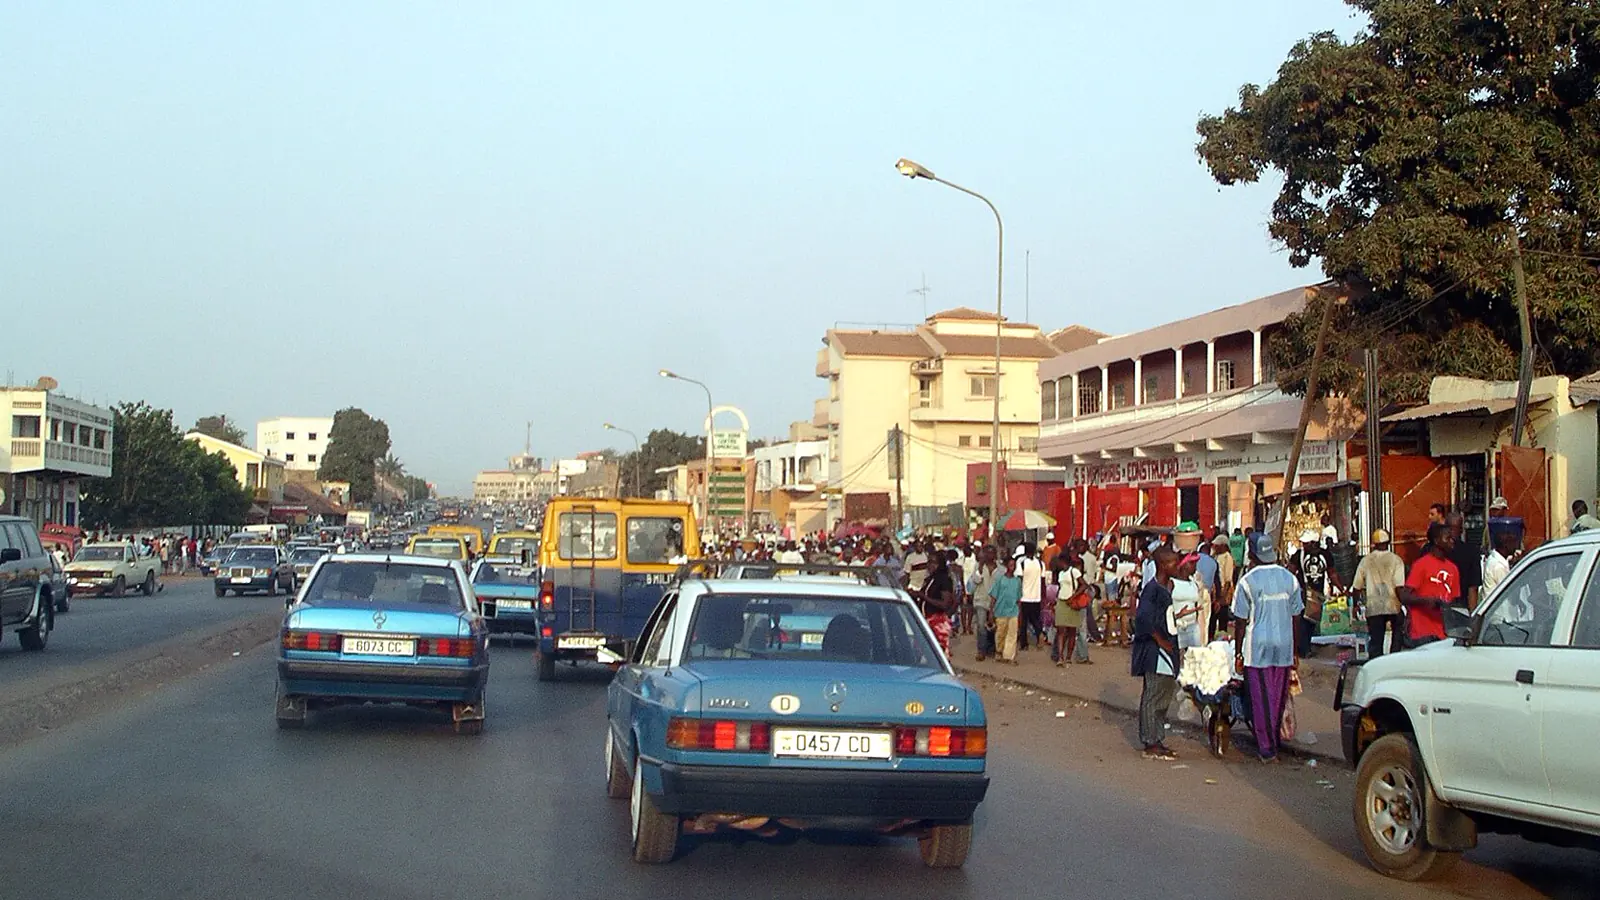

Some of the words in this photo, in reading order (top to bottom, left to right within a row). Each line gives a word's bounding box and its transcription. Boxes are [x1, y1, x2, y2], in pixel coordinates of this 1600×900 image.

[356, 640, 384, 652] 6073
[387, 641, 402, 653] CC
[780, 697, 790, 711] D
[796, 734, 841, 752] 0457
